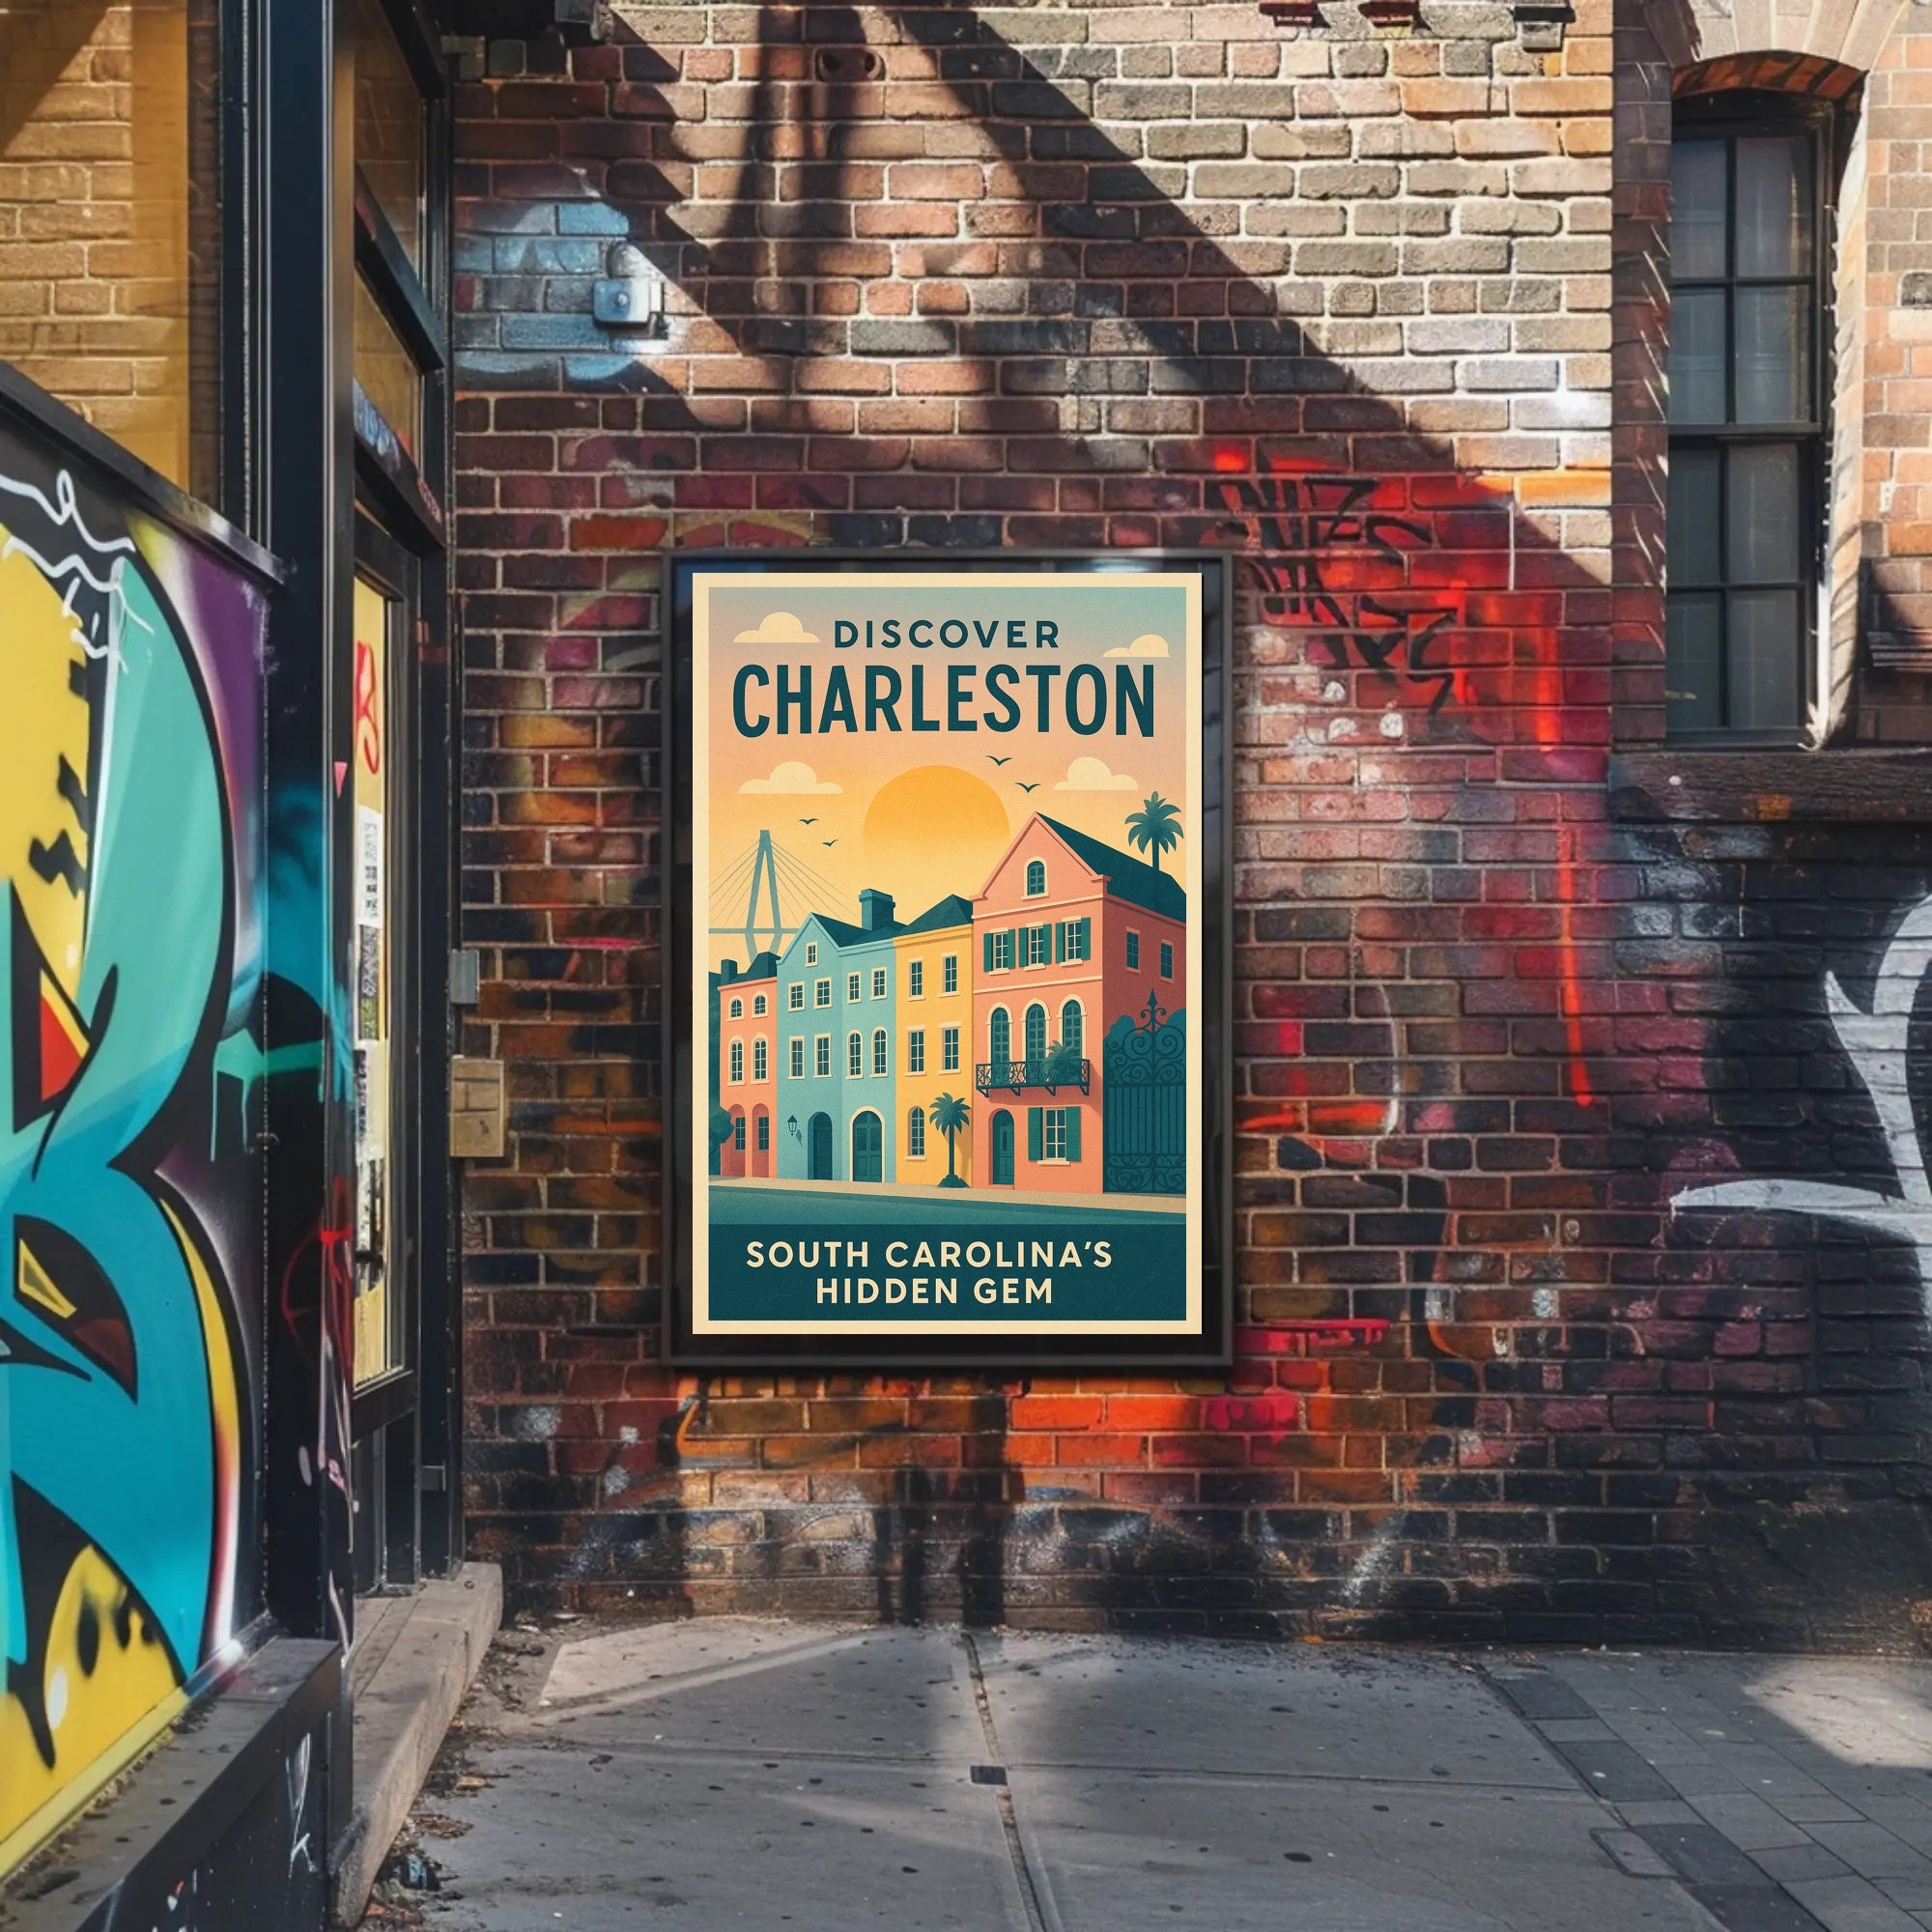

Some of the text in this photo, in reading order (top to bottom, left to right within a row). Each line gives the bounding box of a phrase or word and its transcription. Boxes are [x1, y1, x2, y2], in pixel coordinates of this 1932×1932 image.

[833, 618, 1060, 649] DISCOVER
[731, 663, 1155, 739] CHARLESTON
[745, 1240, 868, 1268] SOUTH
[815, 1277, 1053, 1304] HIDDEN GEM
